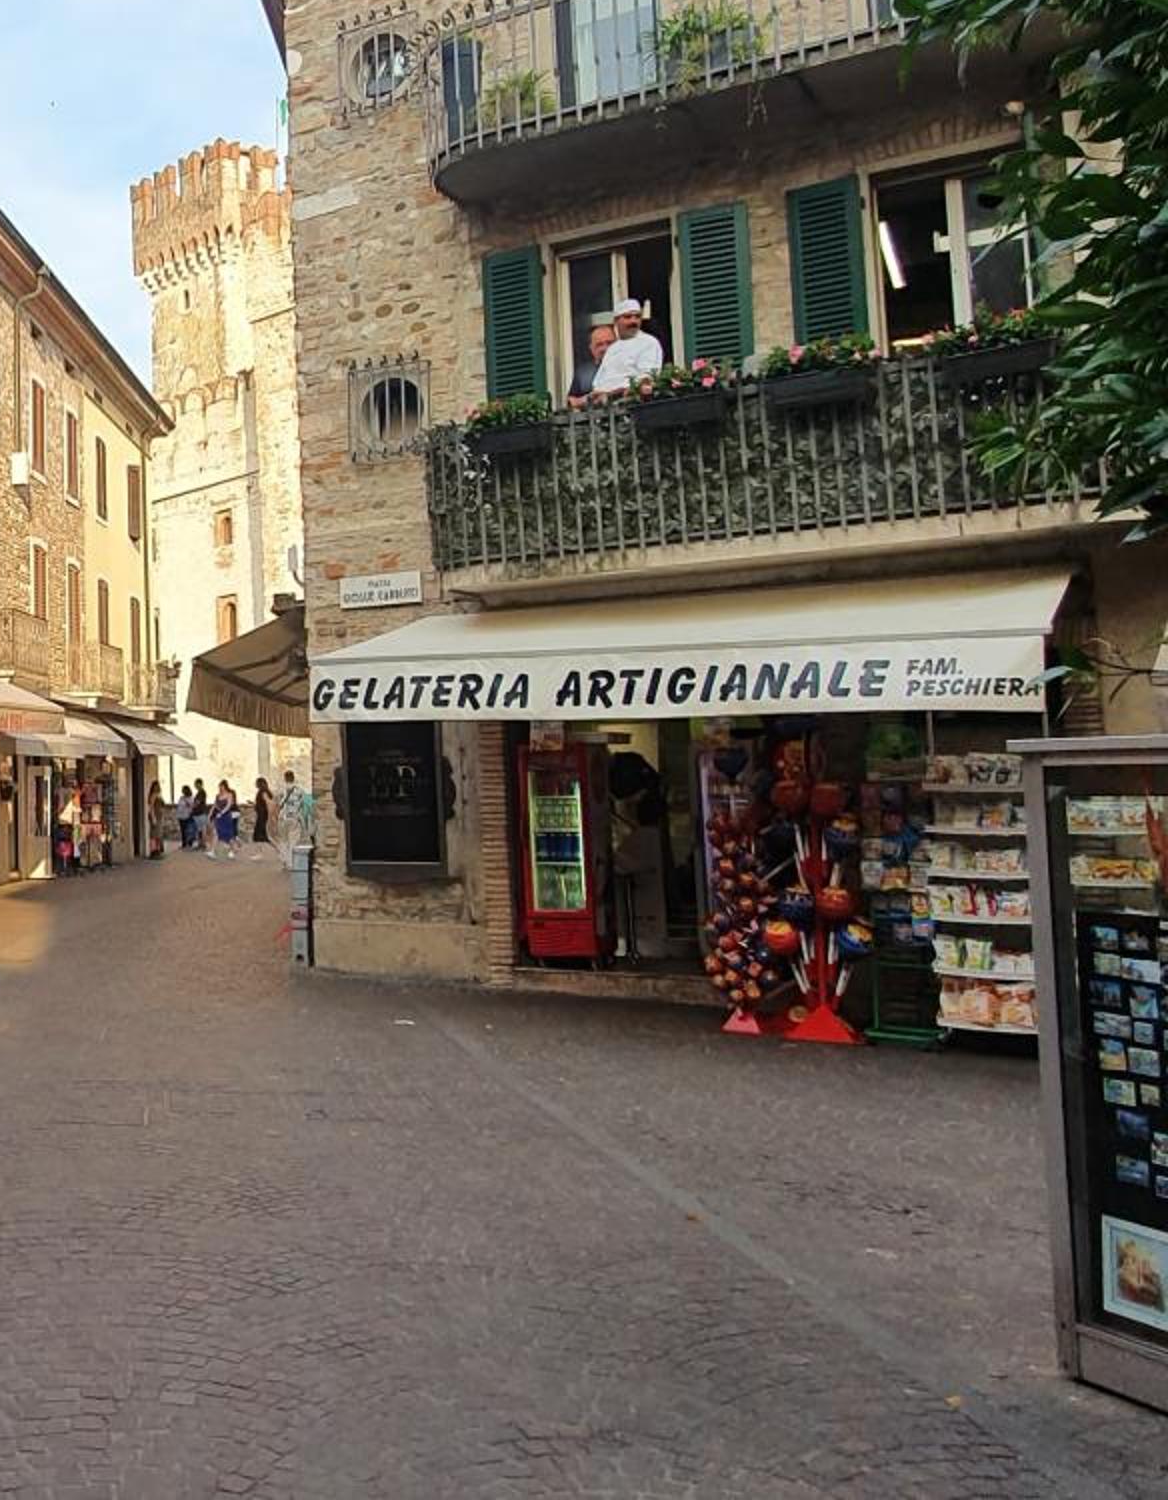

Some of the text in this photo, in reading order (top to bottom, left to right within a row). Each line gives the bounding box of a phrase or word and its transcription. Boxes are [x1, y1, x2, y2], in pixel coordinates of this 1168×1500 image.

[906, 658, 964, 676] FAM.
[313, 659, 891, 711] GELATERIA ARTIGIANALE
[906, 677, 1041, 697] PESCHIERA
